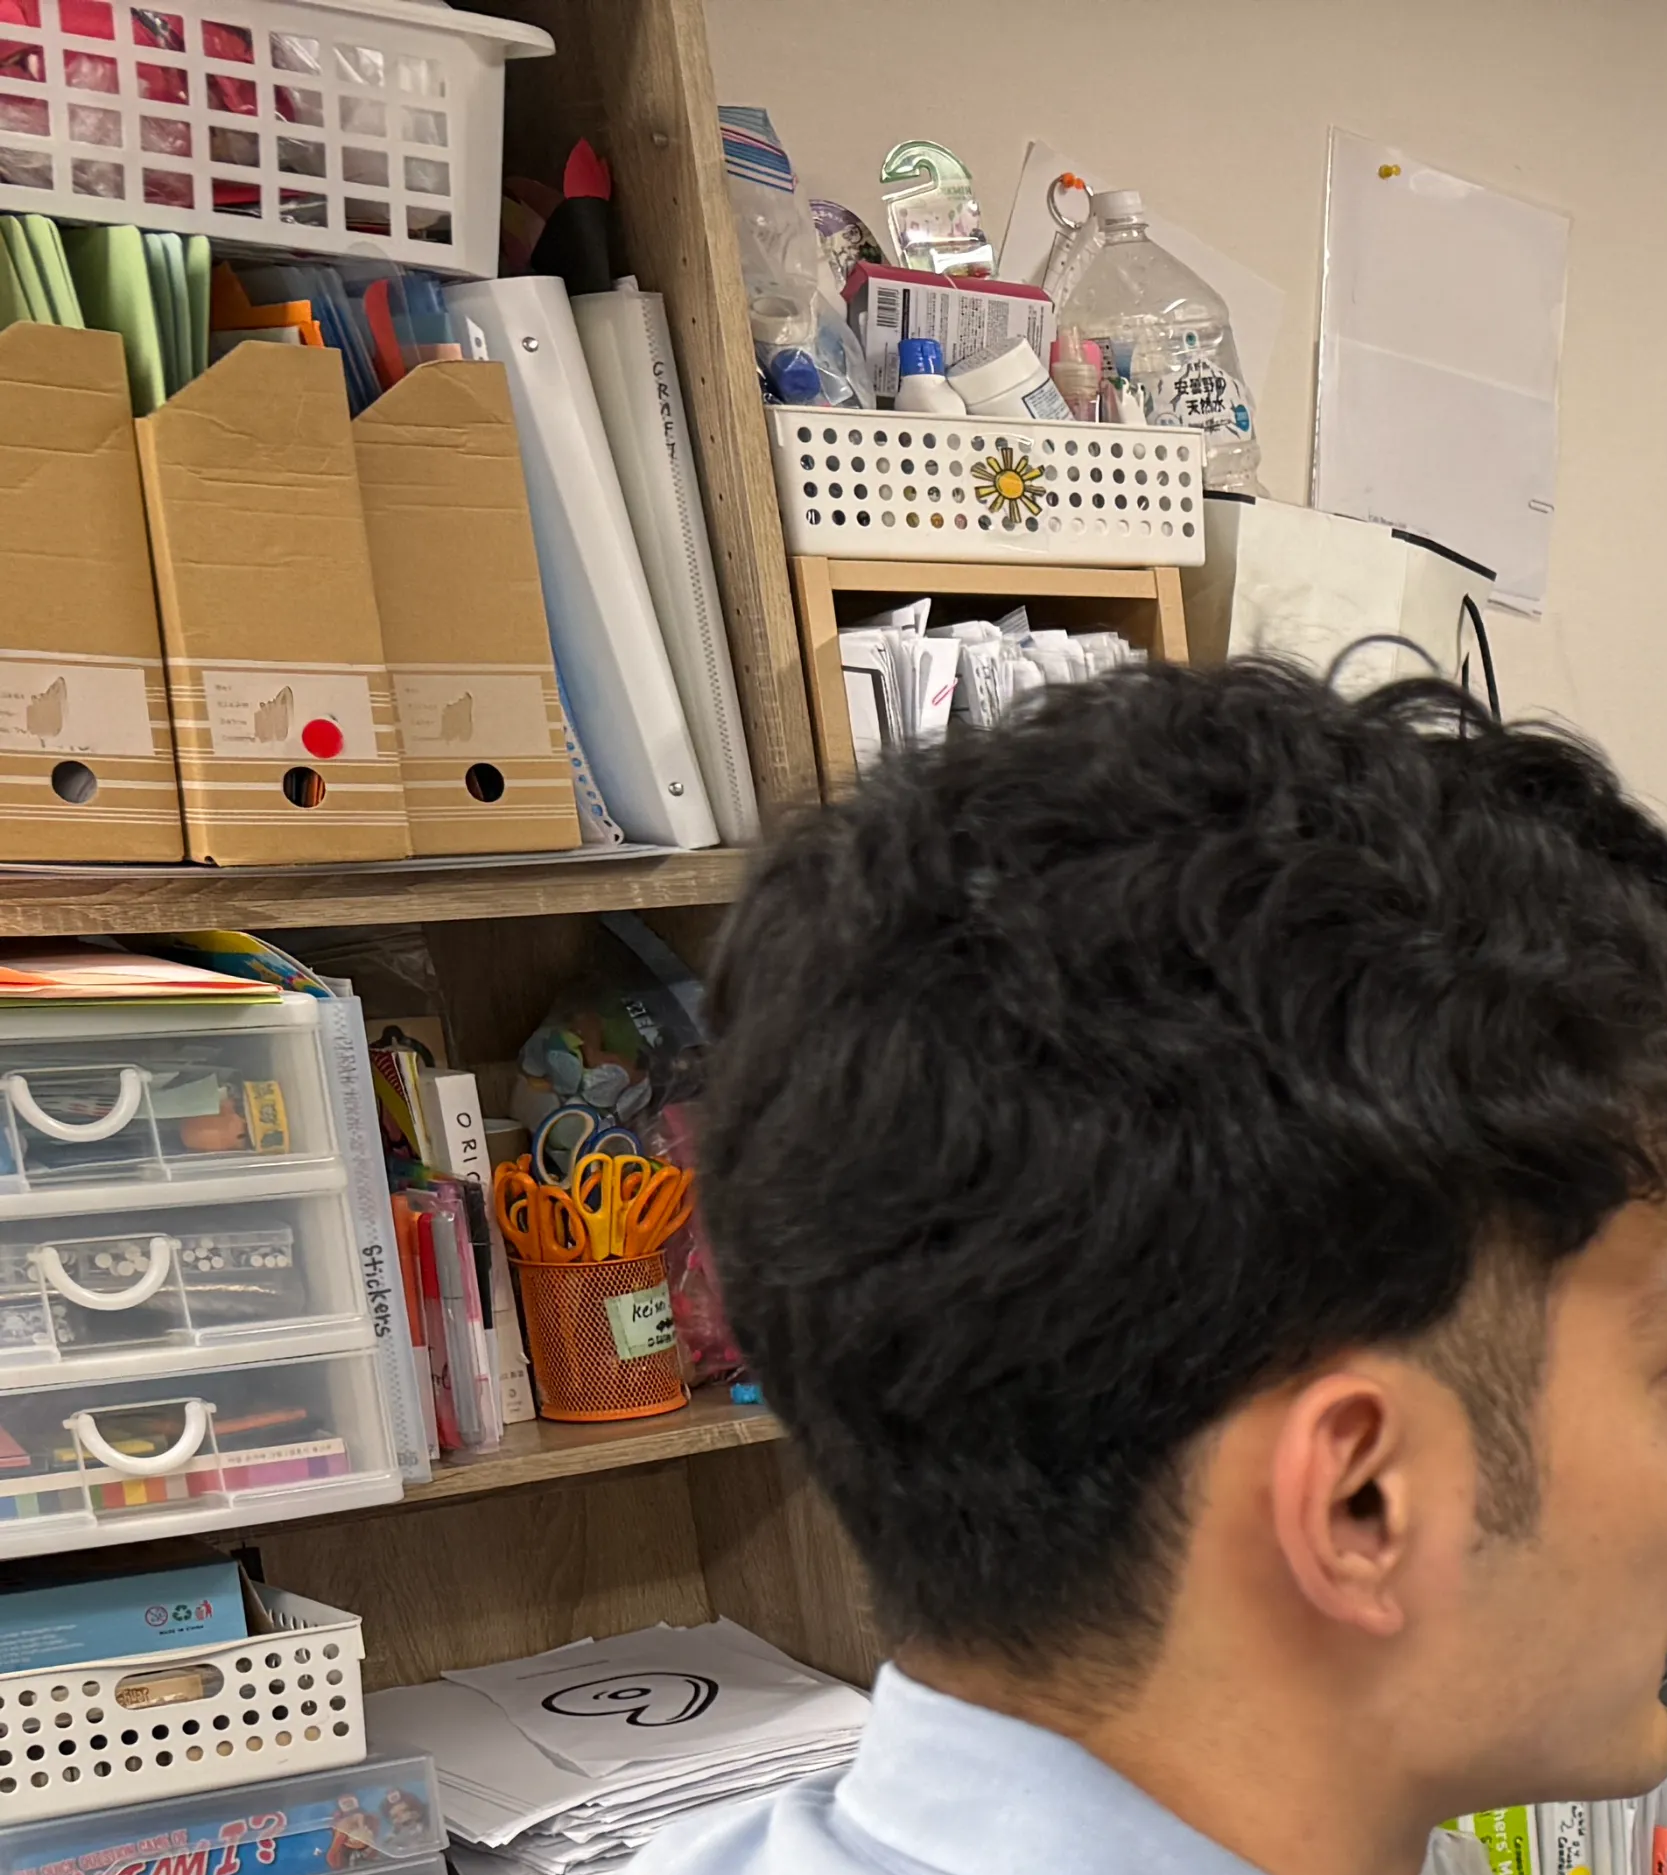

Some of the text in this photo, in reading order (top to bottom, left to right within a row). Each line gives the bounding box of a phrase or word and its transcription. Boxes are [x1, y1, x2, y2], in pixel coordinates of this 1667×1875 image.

[653, 361, 678, 461] CRAFT
[1186, 397, 1225, 415] 天然水
[362, 1244, 391, 1338] Stickers
